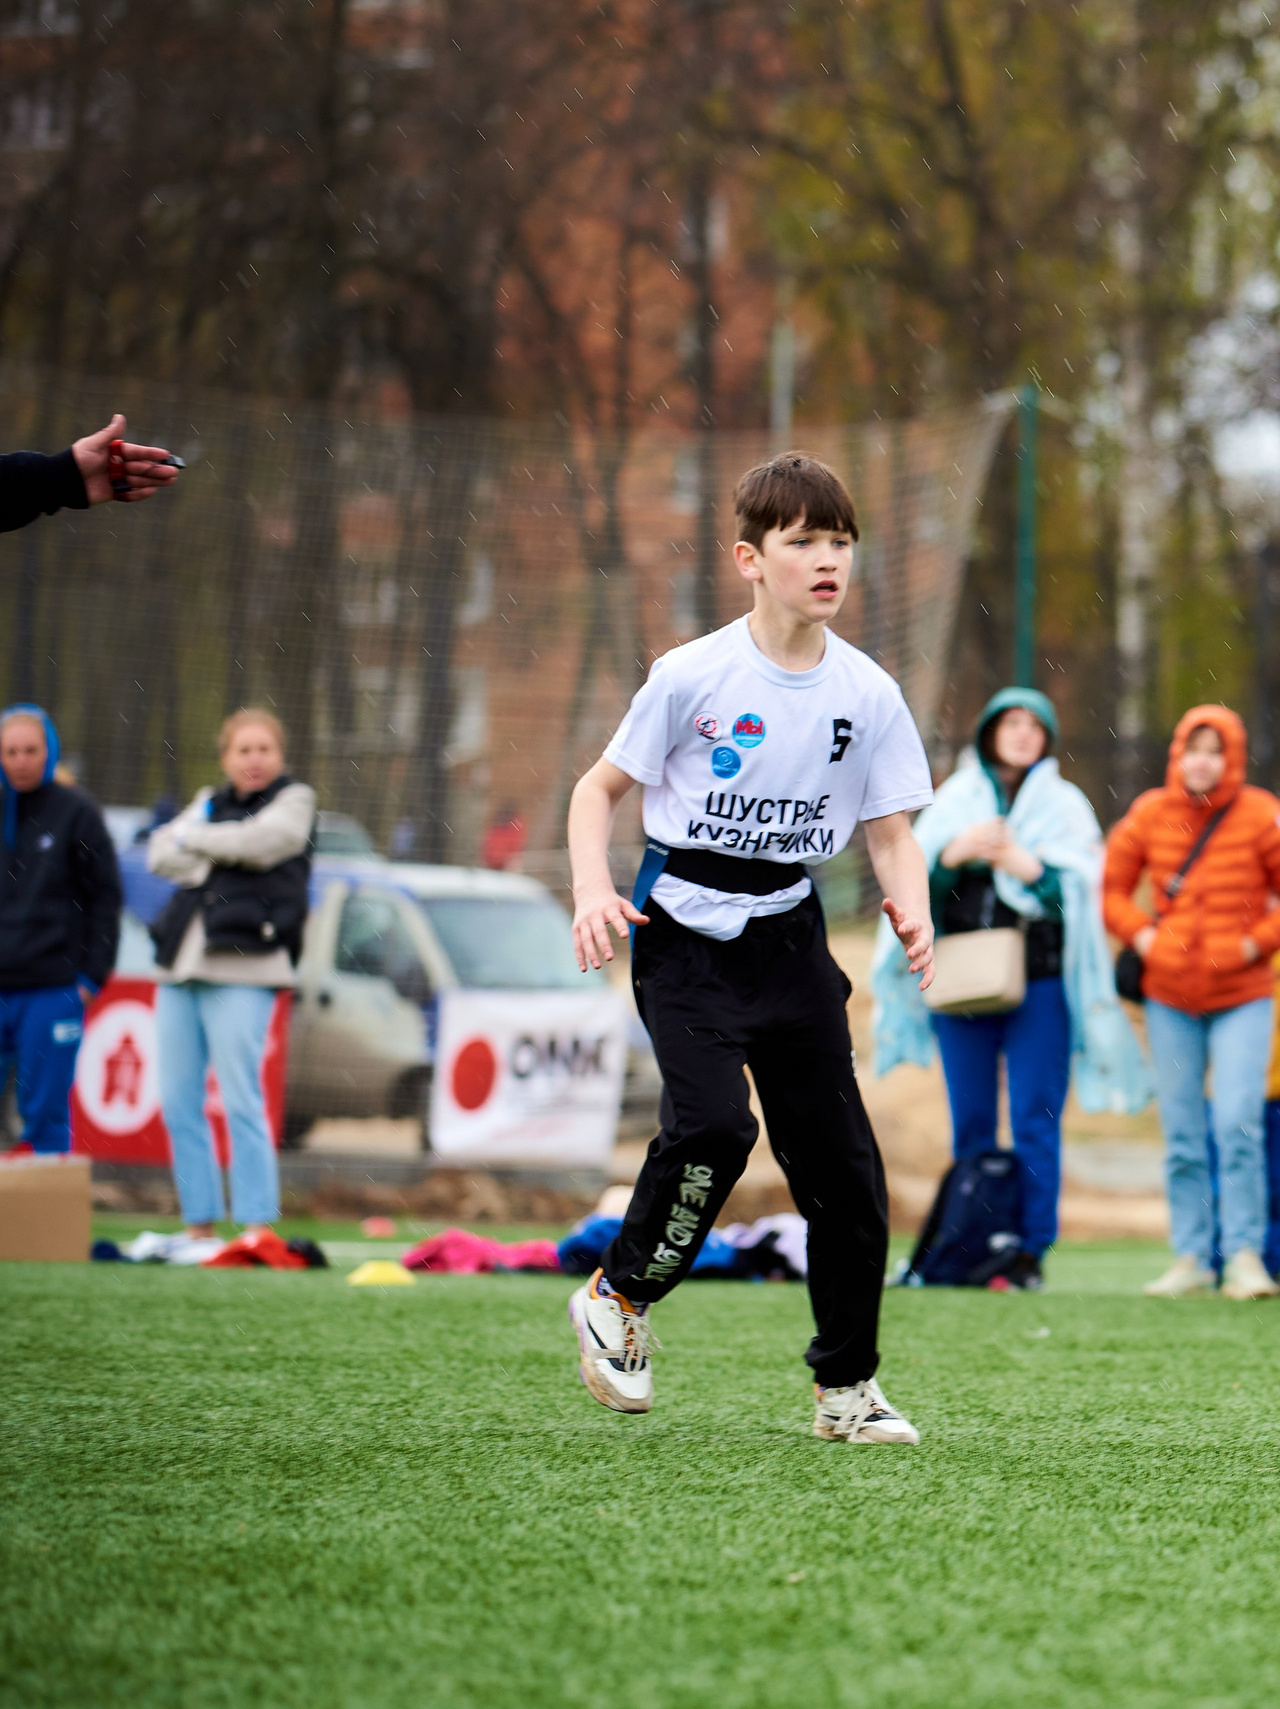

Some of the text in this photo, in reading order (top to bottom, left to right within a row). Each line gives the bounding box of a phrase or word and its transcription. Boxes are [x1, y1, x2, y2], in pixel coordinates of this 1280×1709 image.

[829, 718, 853, 764] 5
[680, 1163, 715, 1209] ONE
[665, 1203, 701, 1247] AND
